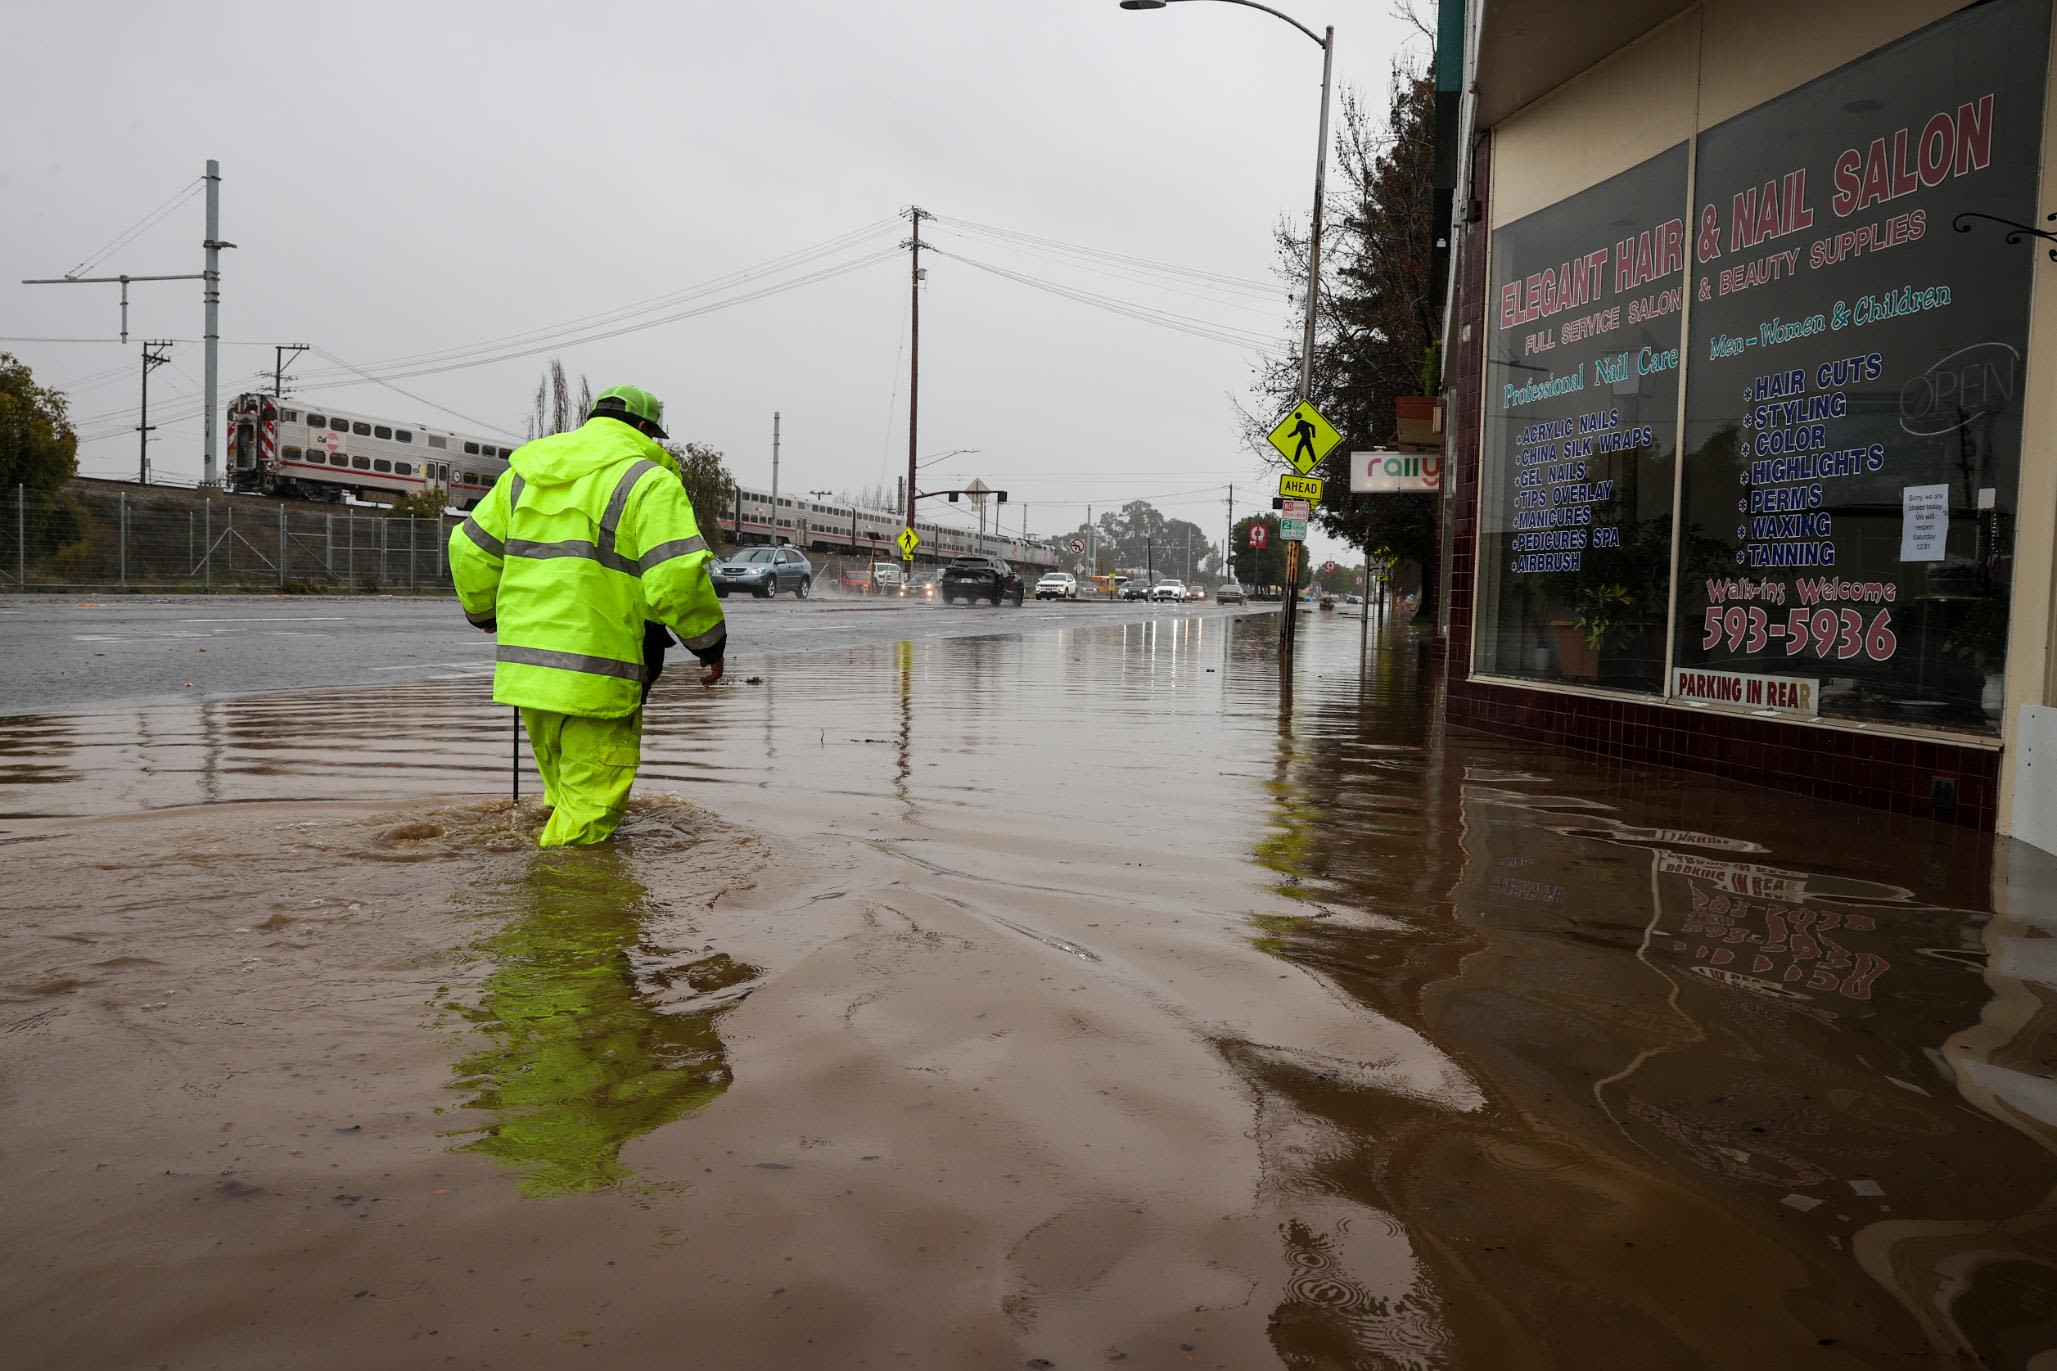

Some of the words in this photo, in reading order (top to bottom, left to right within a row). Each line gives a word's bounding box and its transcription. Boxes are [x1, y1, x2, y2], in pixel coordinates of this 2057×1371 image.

[1500, 248, 1608, 330] ELEGANT
[1615, 218, 1684, 294] HAIR
[1698, 204, 1721, 264] &
[1731, 168, 1814, 253] NAIL
[1832, 93, 1994, 217] SALON
[1525, 329, 1555, 356] FULL
[1562, 306, 1620, 345] SERVICE
[1628, 287, 1683, 325] SALON
[1699, 277, 1711, 301] &
[1719, 247, 1800, 296] BEAUTY
[1809, 209, 1926, 269] SUPPLIES
[1831, 300, 1851, 330] &
[1854, 285, 1951, 326] Children
[1504, 363, 1584, 409] Professional
[1594, 352, 1629, 386] Nail
[1638, 346, 1680, 376] Care
[1755, 369, 1806, 401] HAIR
[1816, 353, 1882, 389] CUTS
[1900, 357, 2014, 420] OPEN
[1522, 418, 1573, 445] ACRYLIC
[1579, 408, 1618, 434] NAILS
[1755, 392, 1847, 430] STYLING
[1522, 444, 1557, 466] CHINA
[1563, 436, 1592, 459] SILK
[1600, 425, 1652, 454] WRAPS
[1755, 424, 1825, 456] COLOR
[1368, 457, 1440, 487] rally
[1520, 468, 1542, 487] GEL
[1548, 461, 1585, 484] NAILS
[1751, 443, 1884, 485] HIGHLIGHTS
[1285, 480, 1317, 494] AHEAD
[1520, 489, 1546, 508] TIPS
[1553, 480, 1613, 505] OVERLAY
[1750, 483, 1823, 514] PERMS
[1282, 520, 1291, 529] 2
[1519, 505, 1591, 529] MANICURES
[1750, 512, 1831, 540] WAXING
[1518, 528, 1586, 551] PEDICURES
[1593, 527, 1620, 548] SPA
[1747, 541, 1835, 568] TANNING
[1517, 551, 1580, 573] AIRBRUSH
[1706, 576, 1785, 606] Walk-ins
[1796, 576, 1896, 606] Welcome
[1703, 606, 1897, 662] 593-5936
[1679, 672, 1742, 702] PARKING
[1746, 679, 1762, 705] IN
[1767, 682, 1811, 710] REAR
